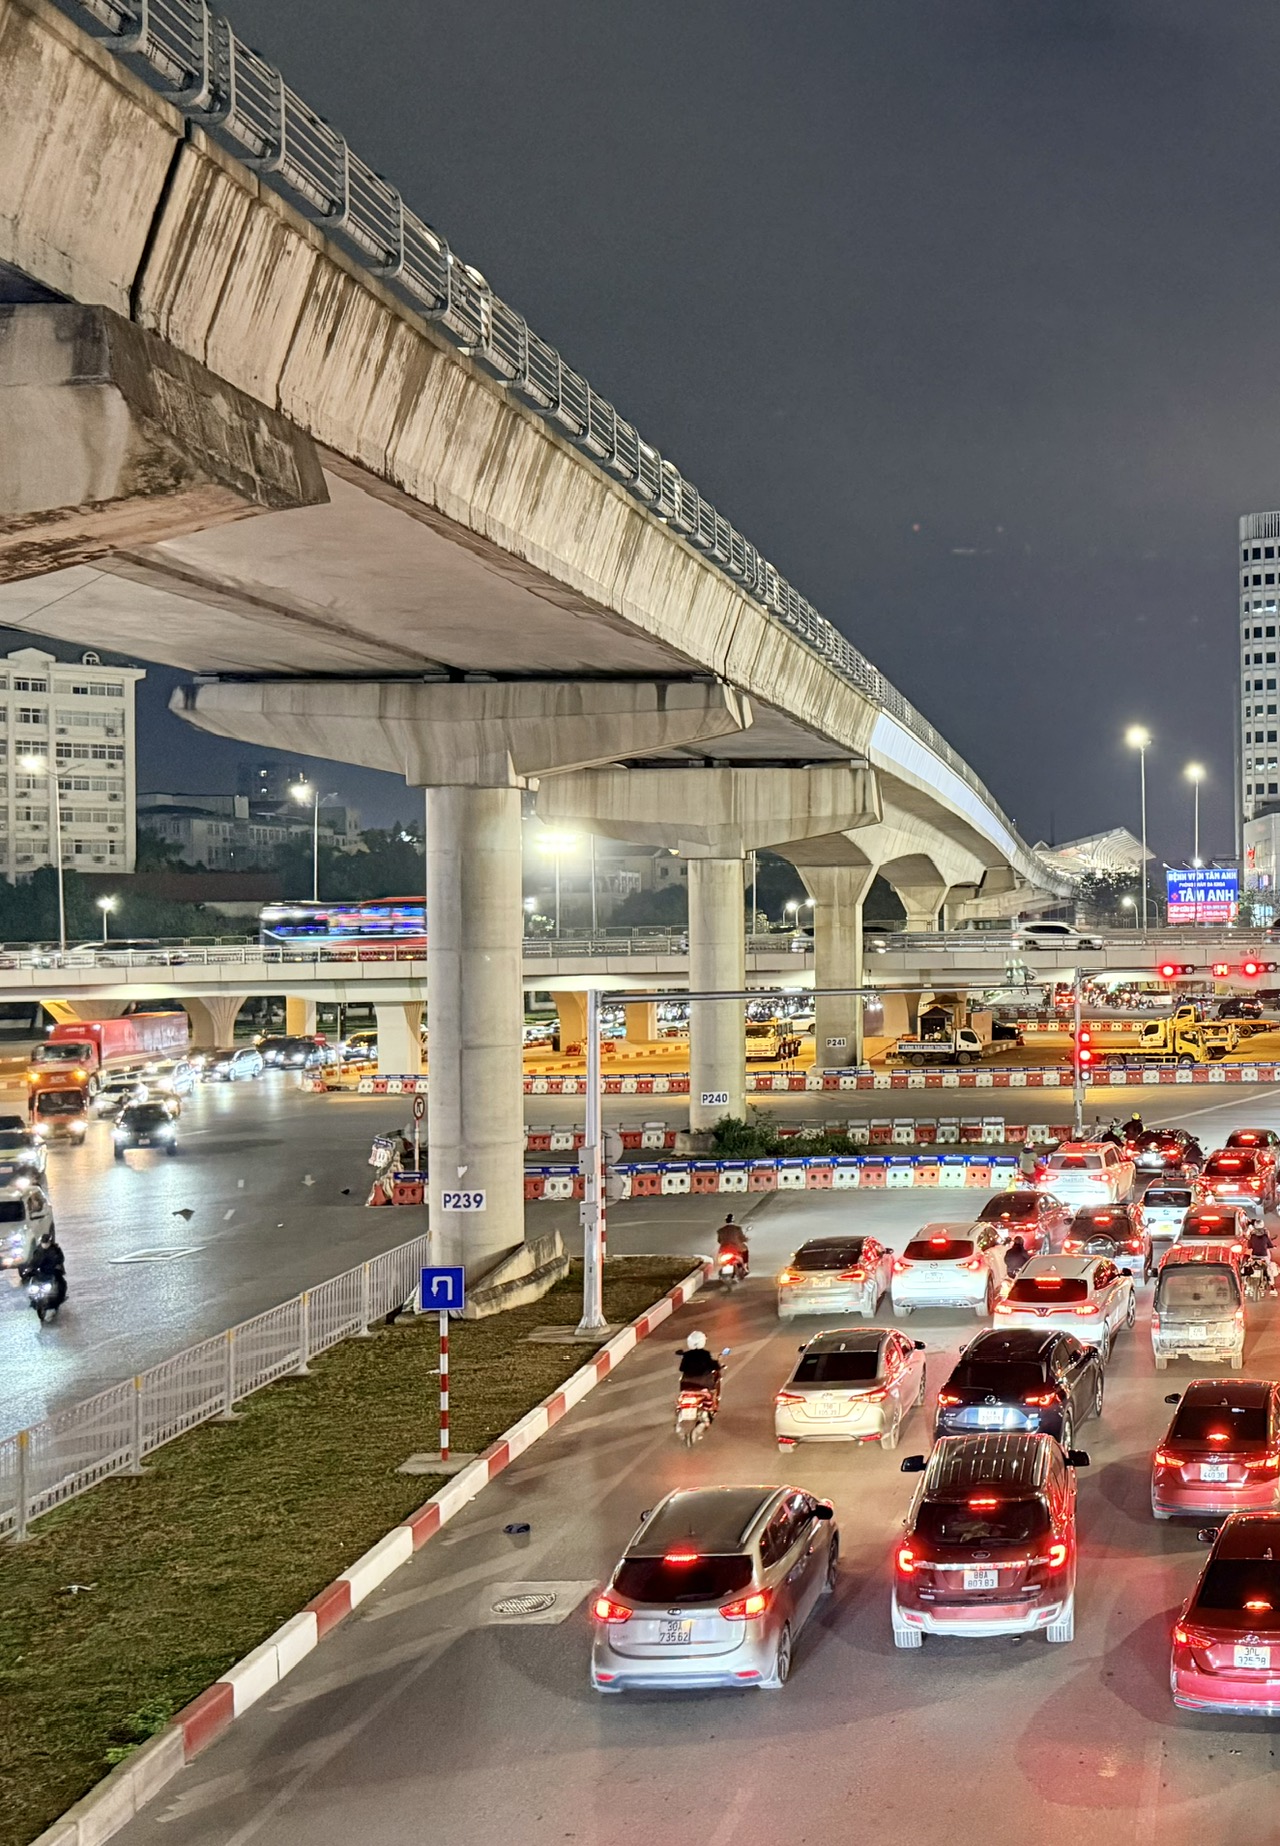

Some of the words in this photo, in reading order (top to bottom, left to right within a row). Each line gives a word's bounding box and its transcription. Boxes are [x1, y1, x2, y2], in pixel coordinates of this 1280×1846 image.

[1205, 871, 1220, 880] TÂM
[1221, 872, 1236, 880] ANH
[1179, 888, 1205, 901] TÂM
[1208, 889, 1234, 901] ANH
[702, 1093, 728, 1104] P240
[443, 1193, 484, 1209] P239
